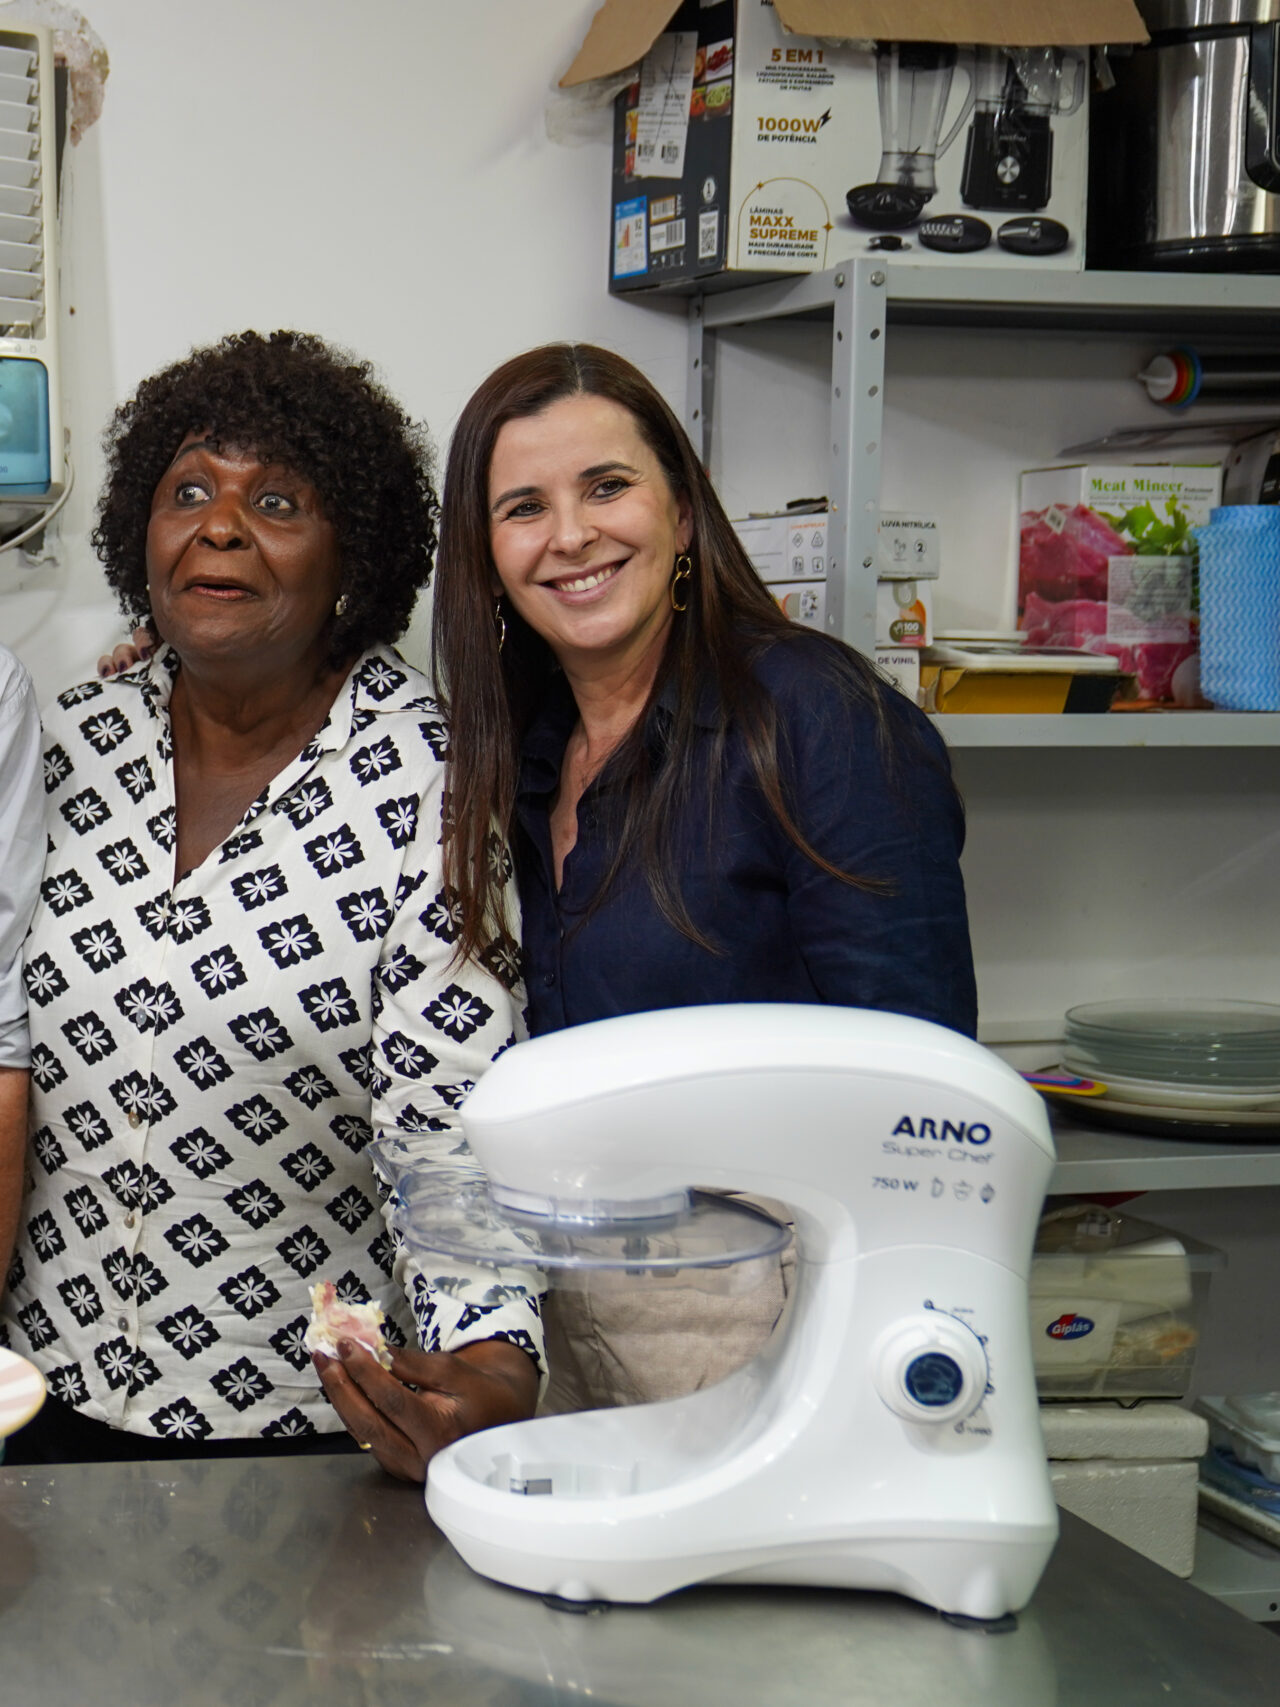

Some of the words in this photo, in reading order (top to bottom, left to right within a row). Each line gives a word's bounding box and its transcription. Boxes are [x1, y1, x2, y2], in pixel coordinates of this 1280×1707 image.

[771, 48, 781, 62] 5
[786, 48, 812, 63] EM
[816, 50, 823, 64] 1
[757, 117, 821, 133] 1000W
[772, 134, 817, 143] POTÊNCIA
[750, 206, 784, 214] LÂMINAS
[750, 215, 795, 228] MAXX
[750, 228, 818, 241] SUPREME
[1091, 479, 1126, 492] Meat
[1133, 479, 1183, 492] Mincer
[882, 520, 900, 528] LUVA
[917, 542, 923, 552] 2
[904, 622, 919, 632] 100
[878, 657, 890, 665] DE
[892, 657, 916, 665] VINIL
[892, 1115, 992, 1145] ARNO
[882, 1141, 942, 1158] Super
[1051, 1322, 1090, 1335] Giplás
